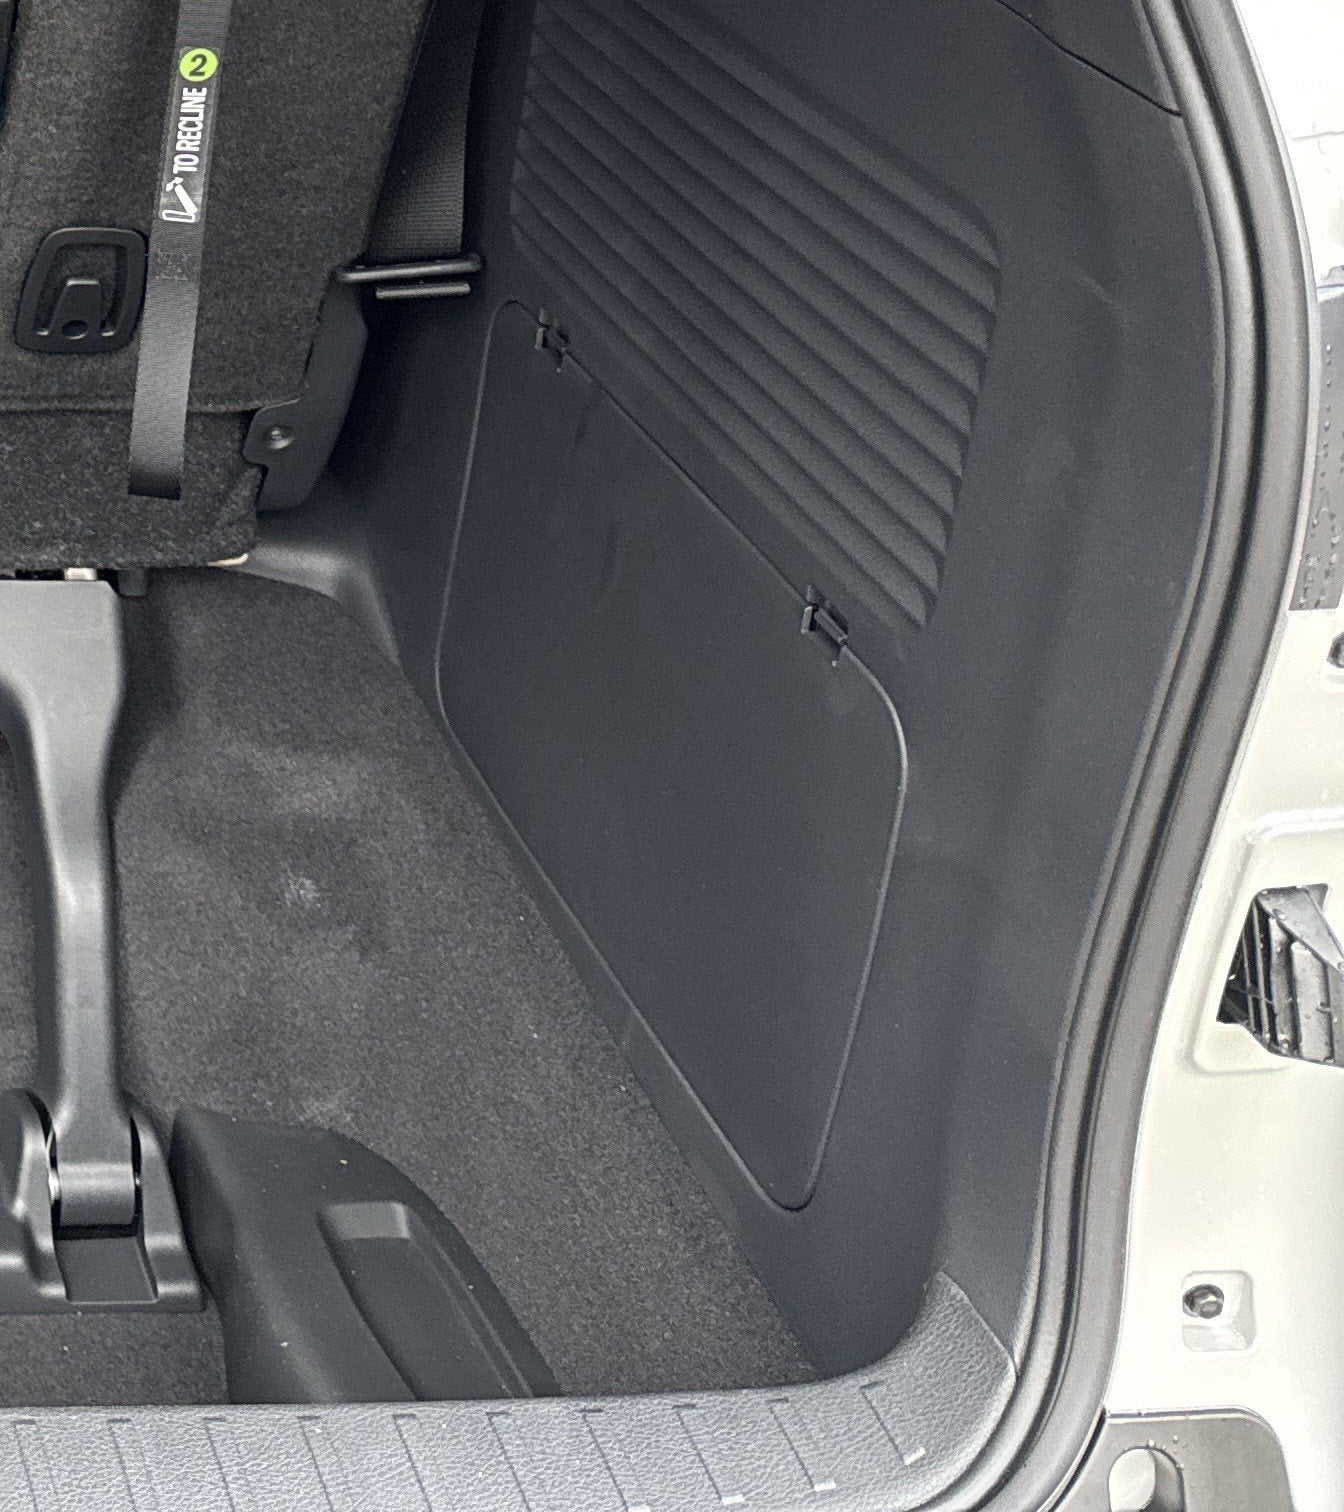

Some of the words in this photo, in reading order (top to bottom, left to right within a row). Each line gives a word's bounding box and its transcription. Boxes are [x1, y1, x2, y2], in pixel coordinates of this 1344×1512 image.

[189, 53, 208, 77] 2
[175, 87, 208, 153] RECLINE
[173, 153, 200, 175] TO
